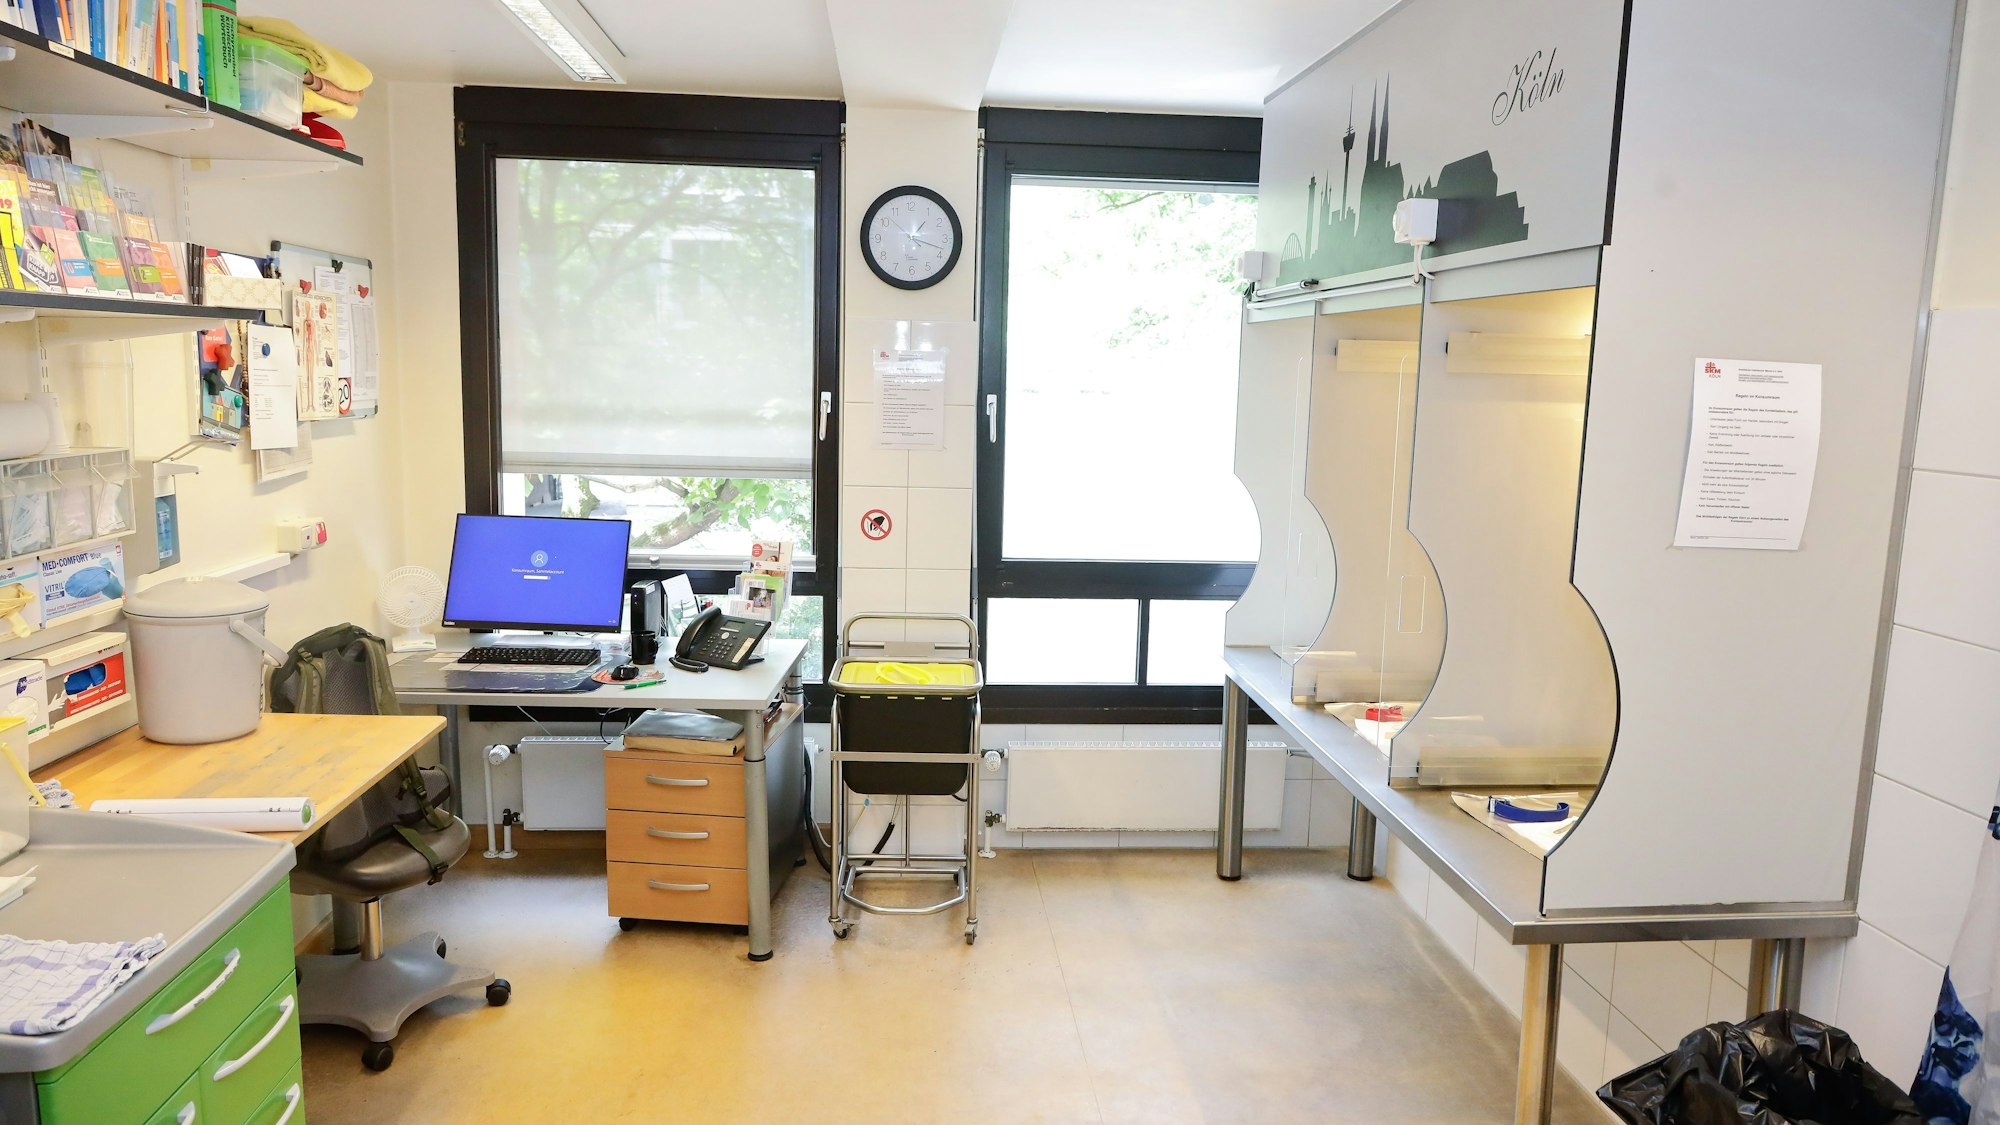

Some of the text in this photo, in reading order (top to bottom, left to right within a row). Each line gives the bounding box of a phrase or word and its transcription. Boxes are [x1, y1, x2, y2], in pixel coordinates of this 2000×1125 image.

[220, 15, 228, 68] Wörterbuch
[1491, 46, 1566, 126] Köln
[907, 202, 915, 211] 12
[892, 208, 899, 216] 11
[881, 218, 889, 227] 10
[936, 218, 942, 227] 2
[875, 233, 881, 243] 9
[942, 233, 948, 243] 3
[881, 251, 887, 260] 8
[937, 250, 942, 259] 4
[893, 262, 899, 271] 7
[909, 266, 915, 275] 6
[925, 262, 931, 271] 5
[44, 583, 65, 593] VITRIL
